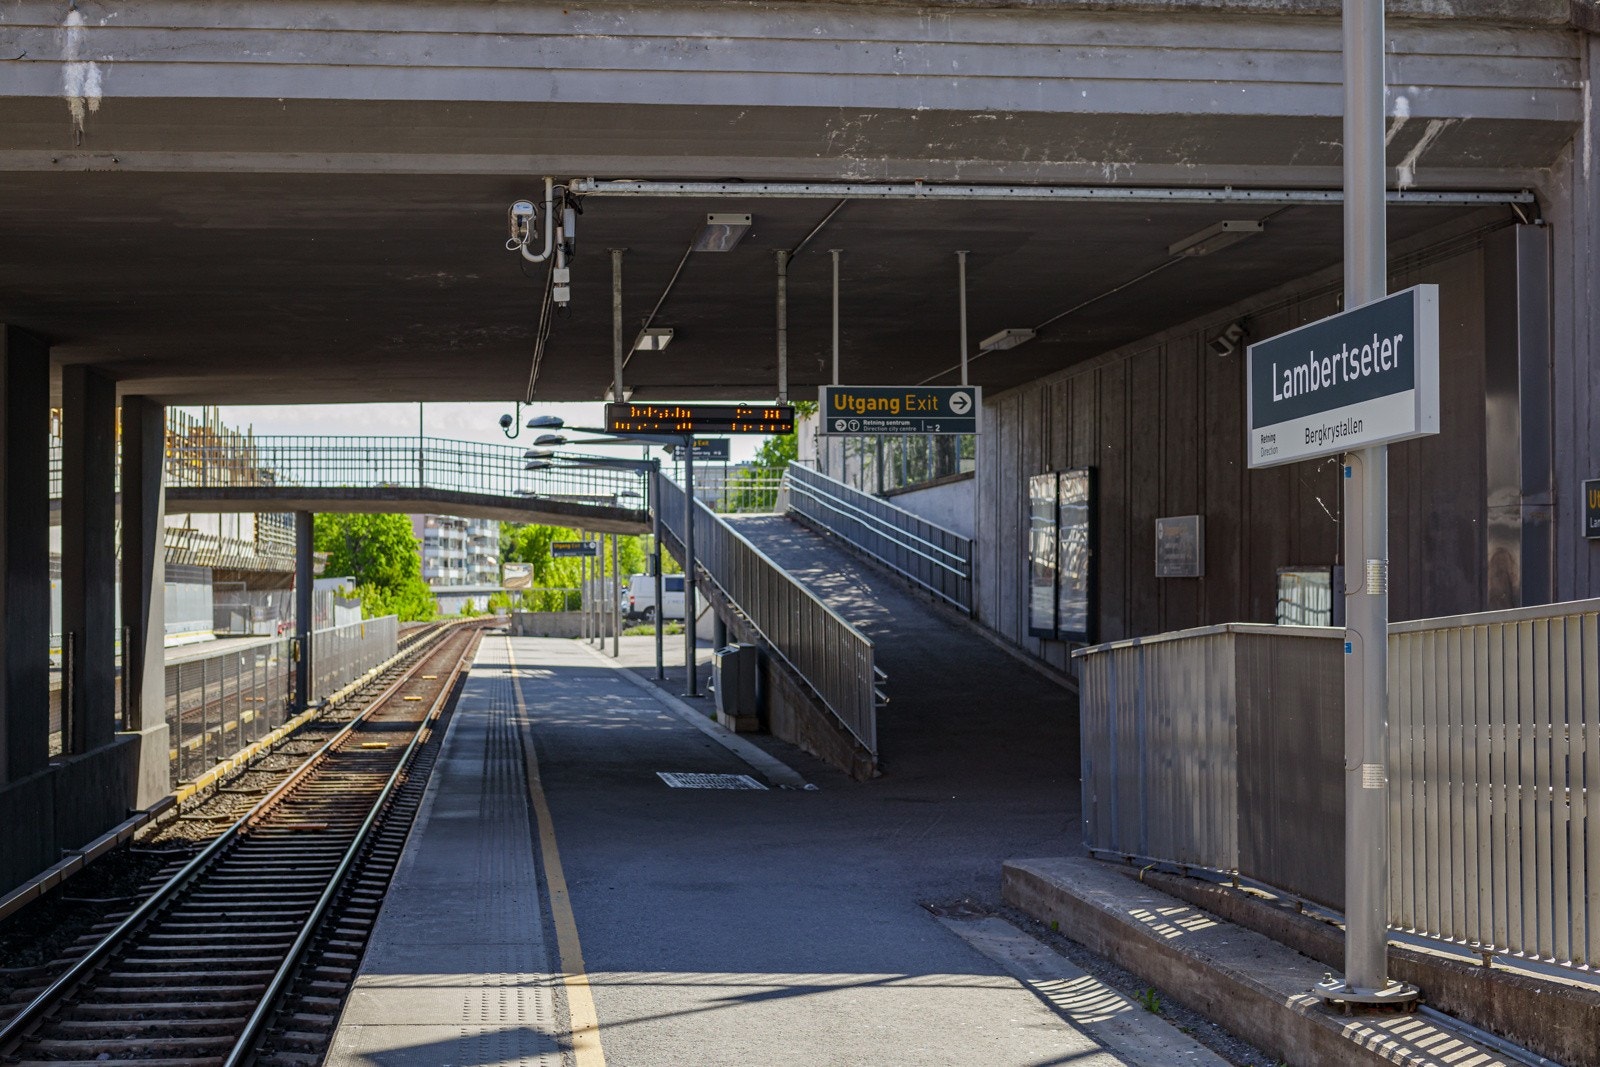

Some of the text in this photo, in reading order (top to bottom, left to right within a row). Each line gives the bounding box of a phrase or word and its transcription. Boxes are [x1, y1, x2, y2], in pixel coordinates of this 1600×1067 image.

[1272, 333, 1403, 402] Lambertseter
[834, 393, 939, 414] Utgang Exit
[935, 424, 941, 432] 2
[1304, 417, 1363, 446] Bergkrystallen
[1260, 433, 1276, 444] Retning
[1260, 446, 1278, 457] Direction
